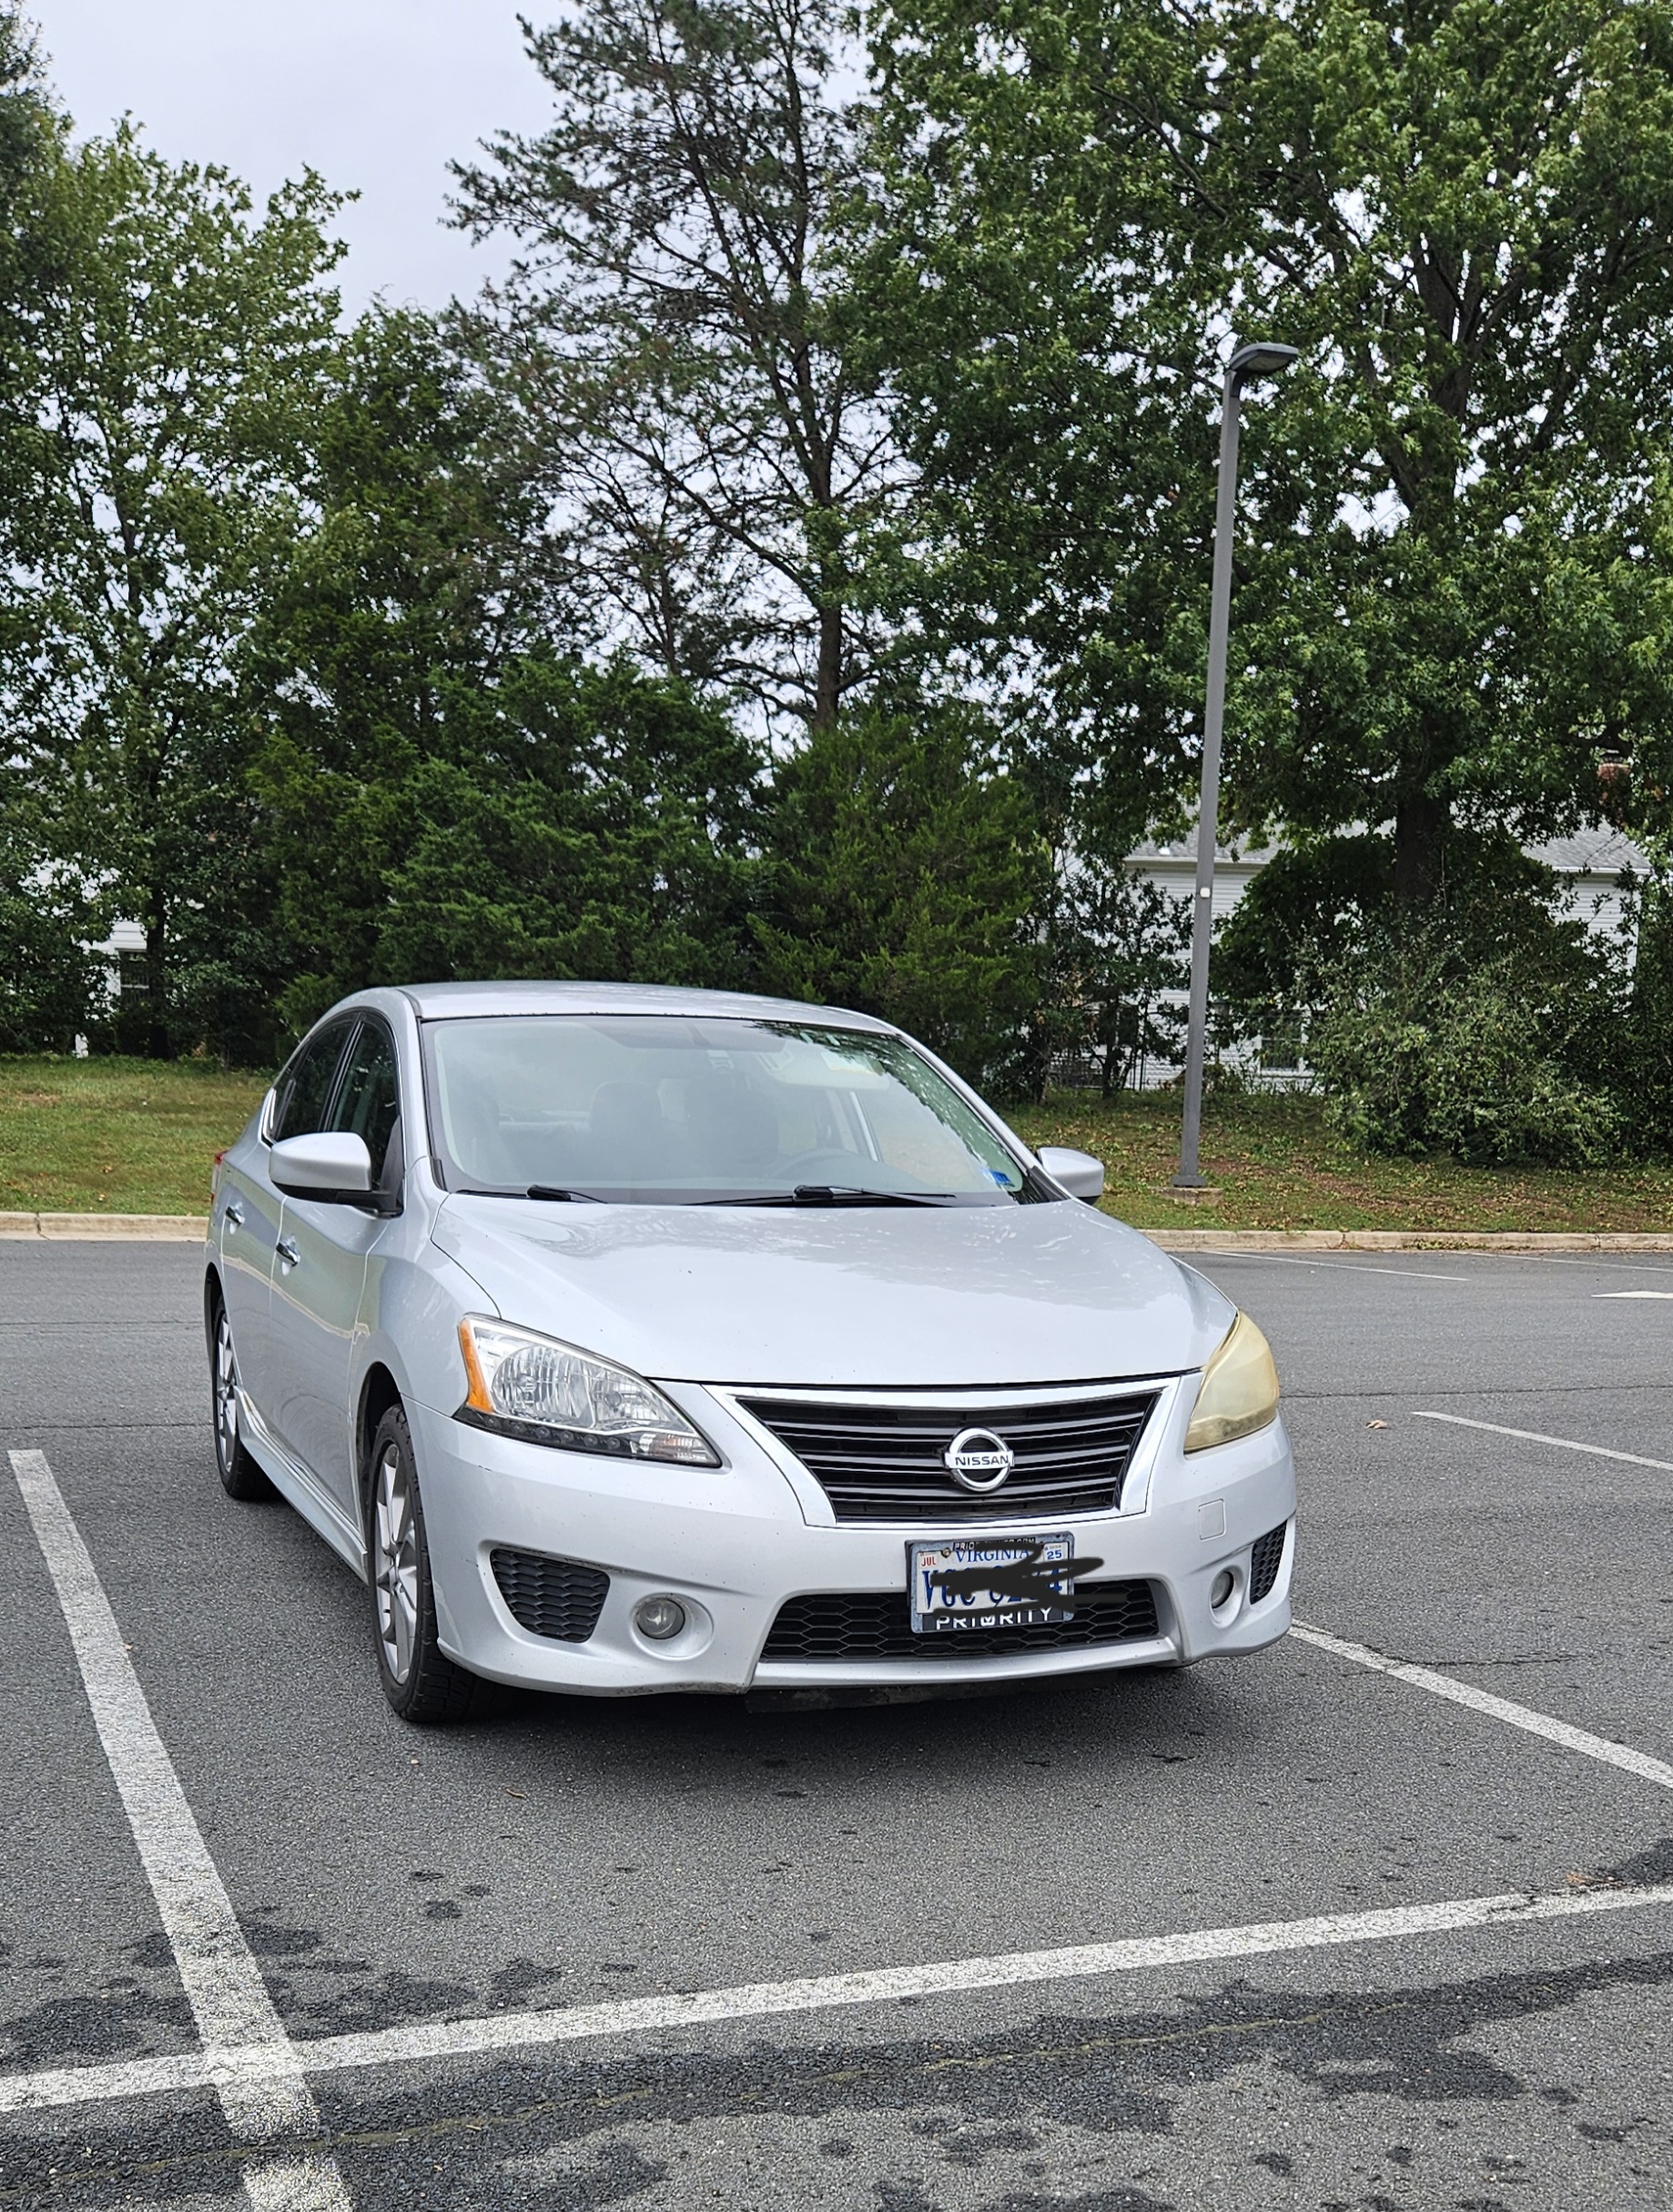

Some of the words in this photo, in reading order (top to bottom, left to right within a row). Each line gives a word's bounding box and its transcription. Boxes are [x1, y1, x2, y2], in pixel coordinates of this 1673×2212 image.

[955, 1456, 1009, 1466] NISSAN
[955, 1548, 1030, 1563] VIRGINIA
[1047, 1549, 1062, 1560] 25
[921, 1556, 937, 1567] JUL
